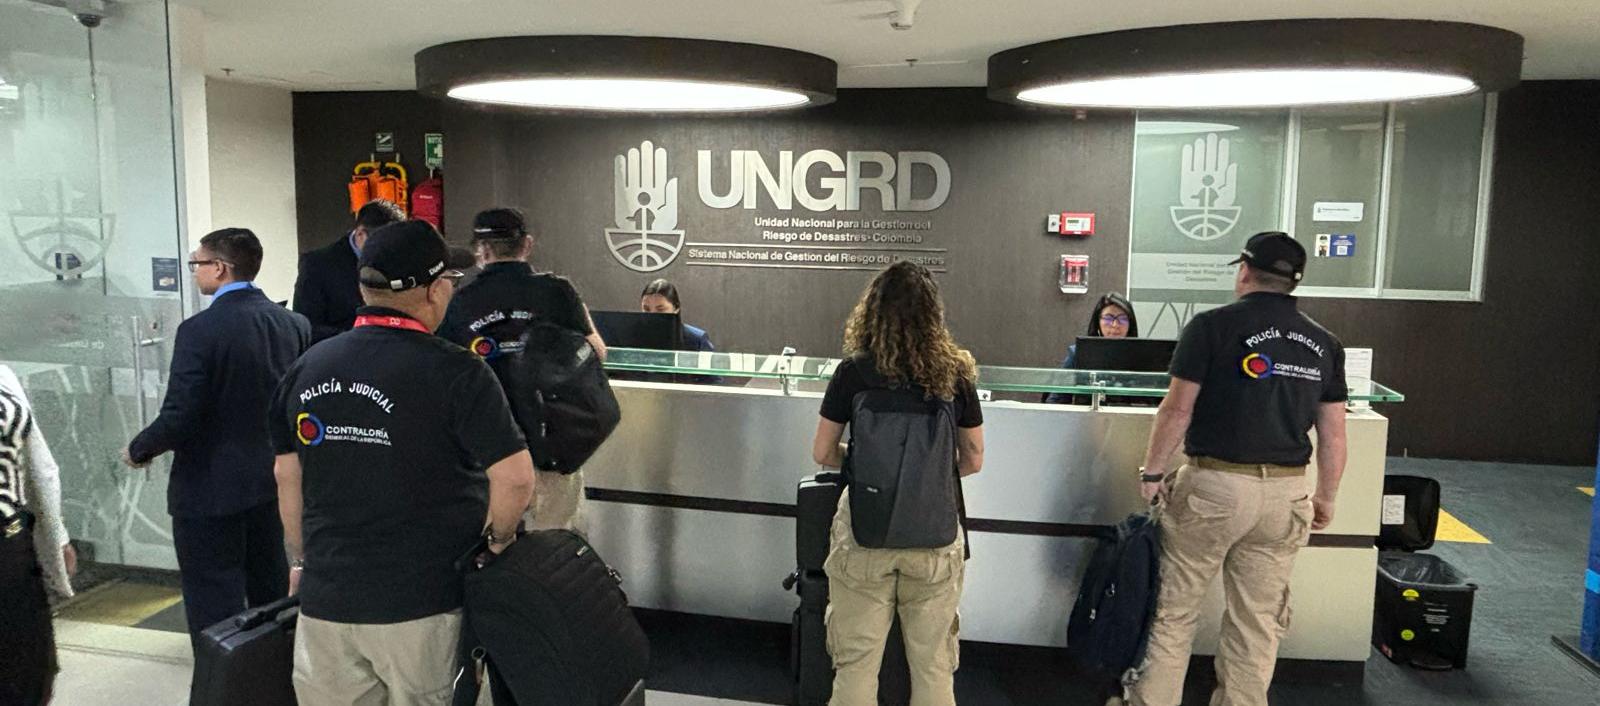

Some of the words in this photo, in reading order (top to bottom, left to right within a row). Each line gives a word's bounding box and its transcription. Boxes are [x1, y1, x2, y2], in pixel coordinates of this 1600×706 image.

[697, 149, 951, 212] UNGRD
[754, 217, 789, 228] Unidad
[791, 218, 835, 229] Nacional
[836, 219, 859, 230] para
[763, 230, 798, 242] Riesgo
[799, 232, 812, 241] de
[872, 233, 922, 244] Colombia
[688, 249, 727, 259] Sistema
[728, 250, 769, 261] Nacional
[770, 251, 783, 260] de
[824, 253, 839, 263] del
[840, 253, 876, 264] Riesgo
[877, 254, 890, 264] de
[469, 310, 505, 332] POLICÍA
[1246, 327, 1281, 348] POLICÍA
[1287, 331, 1324, 356] JUDICIAL
[300, 378, 342, 404] POLICÍA
[349, 382, 395, 414] JUDICIAL
[326, 426, 389, 439] CONTRALORÍA
